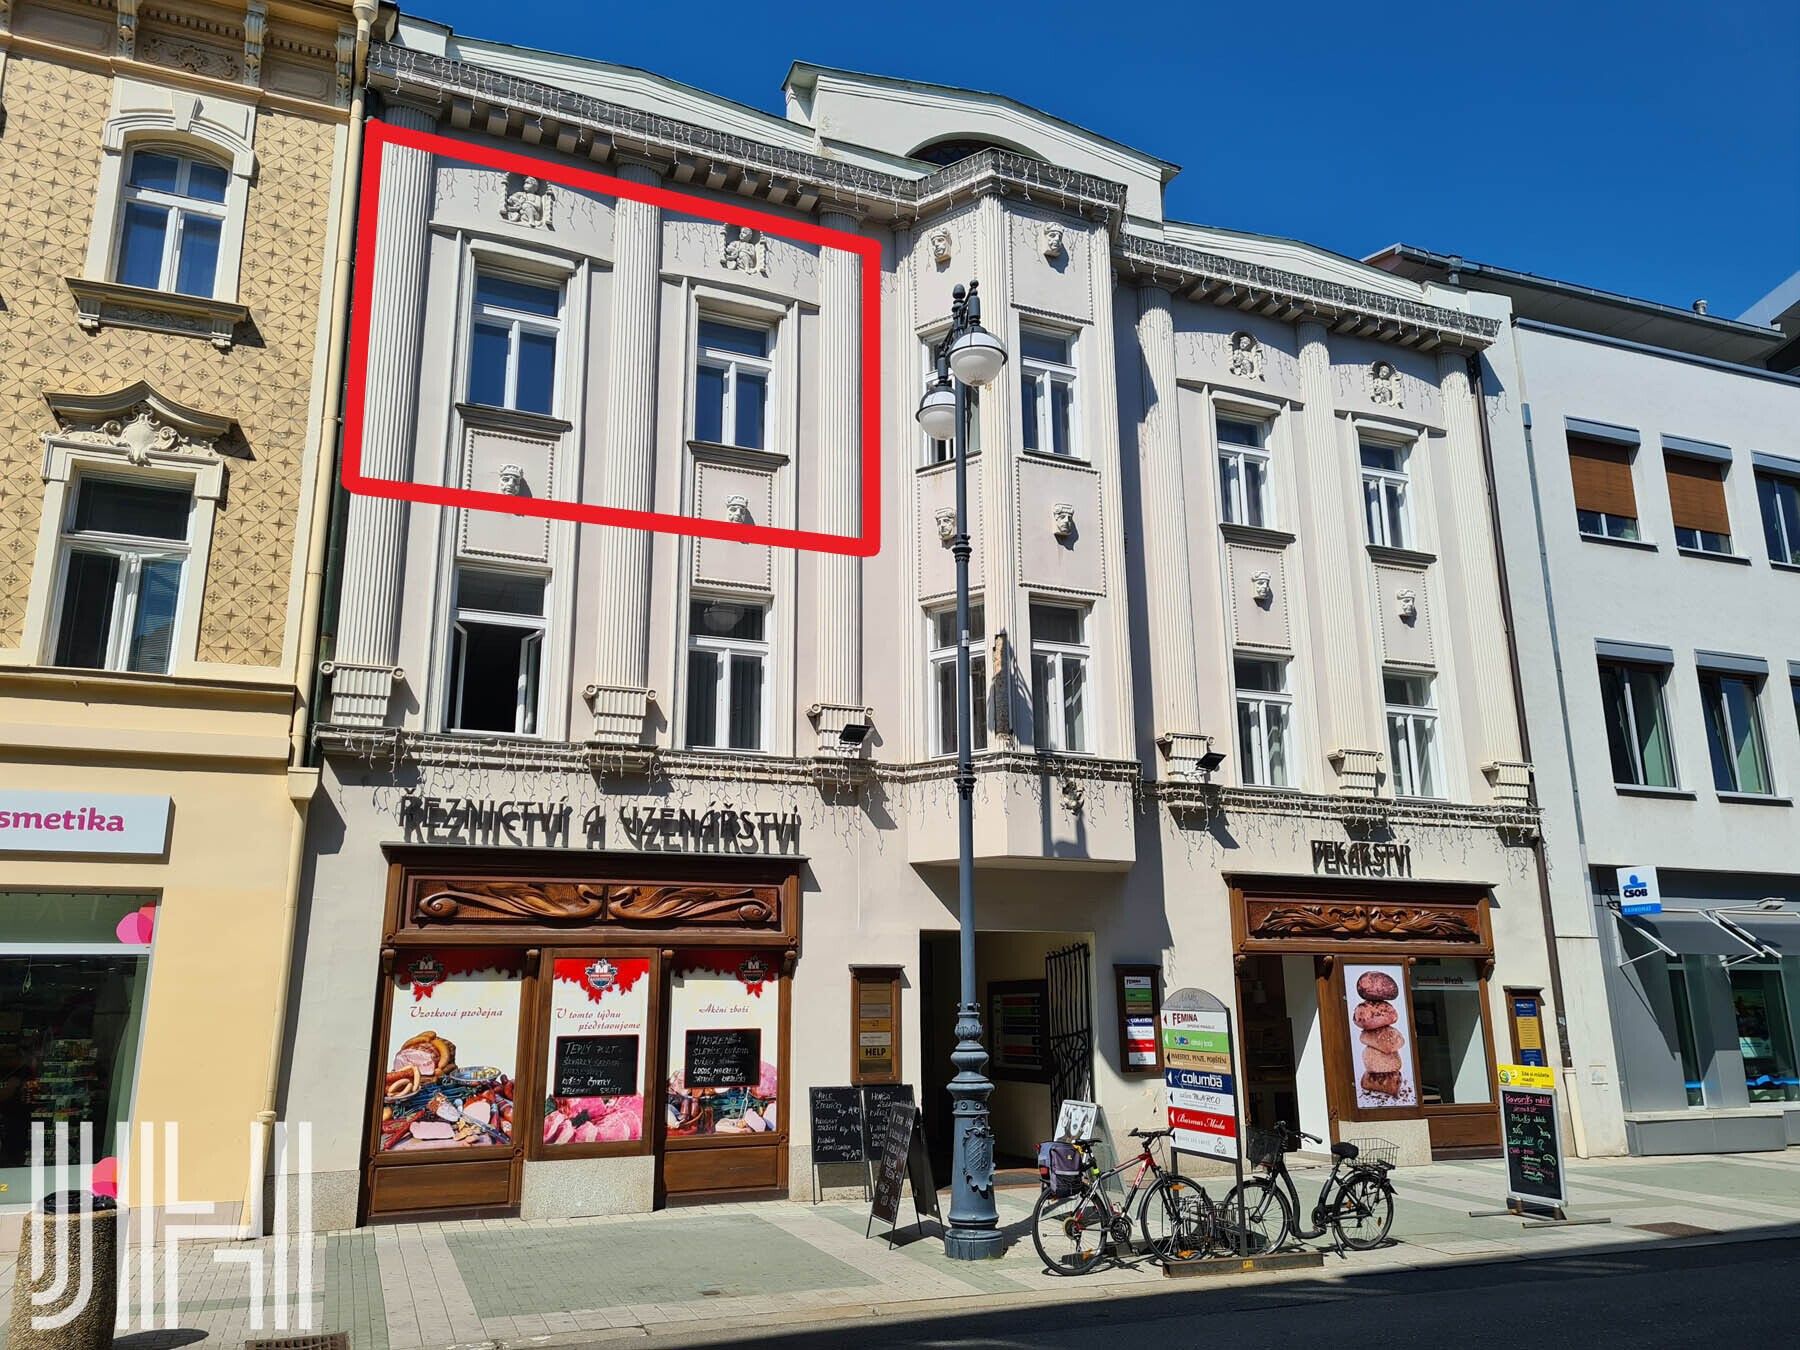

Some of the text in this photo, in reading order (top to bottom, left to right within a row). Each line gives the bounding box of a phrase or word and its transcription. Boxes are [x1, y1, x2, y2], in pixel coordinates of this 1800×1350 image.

[399, 788, 801, 844] ŘEZNICTVÍ A UZENÁŘSTVÍ
[461, 1007, 502, 1018] prodejna
[569, 1011, 593, 1019] tomto
[597, 1009, 621, 1020] týdnu
[1172, 1013, 1198, 1026] FEMINA
[865, 1048, 886, 1056] HELP
[1181, 1072, 1223, 1088] columba
